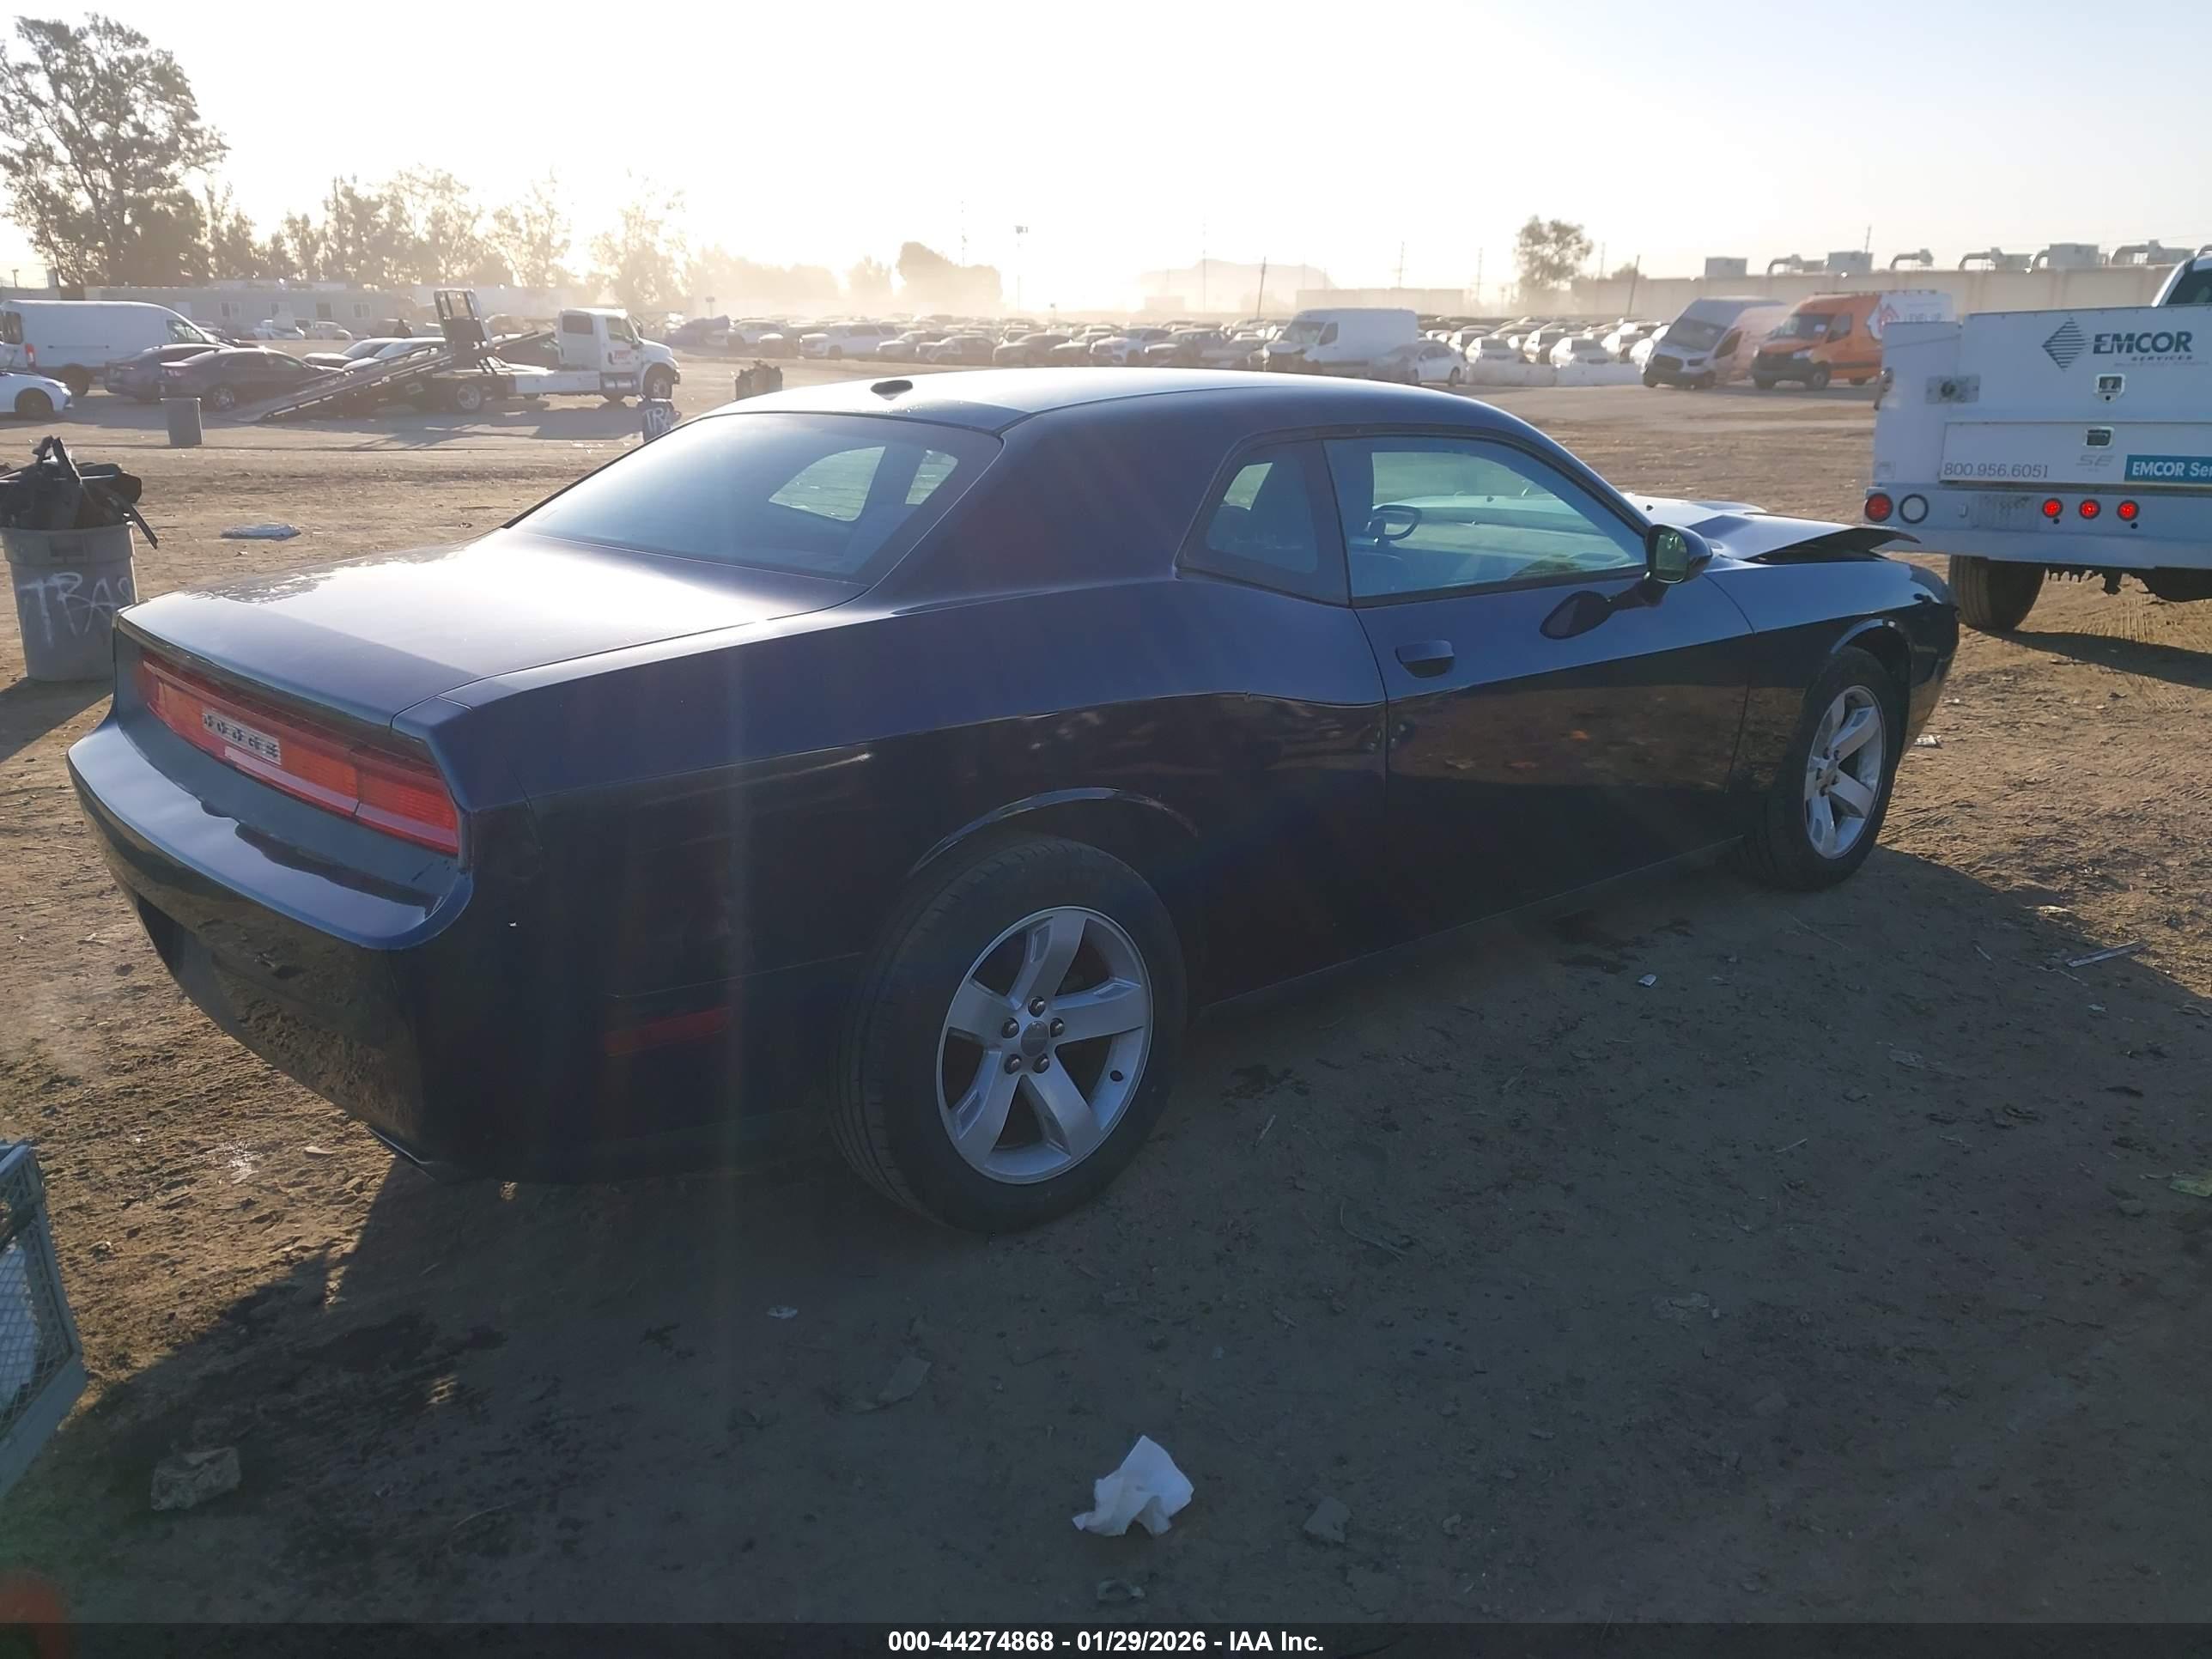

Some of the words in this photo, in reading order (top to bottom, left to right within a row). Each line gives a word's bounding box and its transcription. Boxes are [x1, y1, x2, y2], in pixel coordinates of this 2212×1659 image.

[2093, 331, 2193, 355] EMCOR
[1943, 462, 2049, 478] 800.956.6051
[2131, 461, 2185, 477] EMCOR
